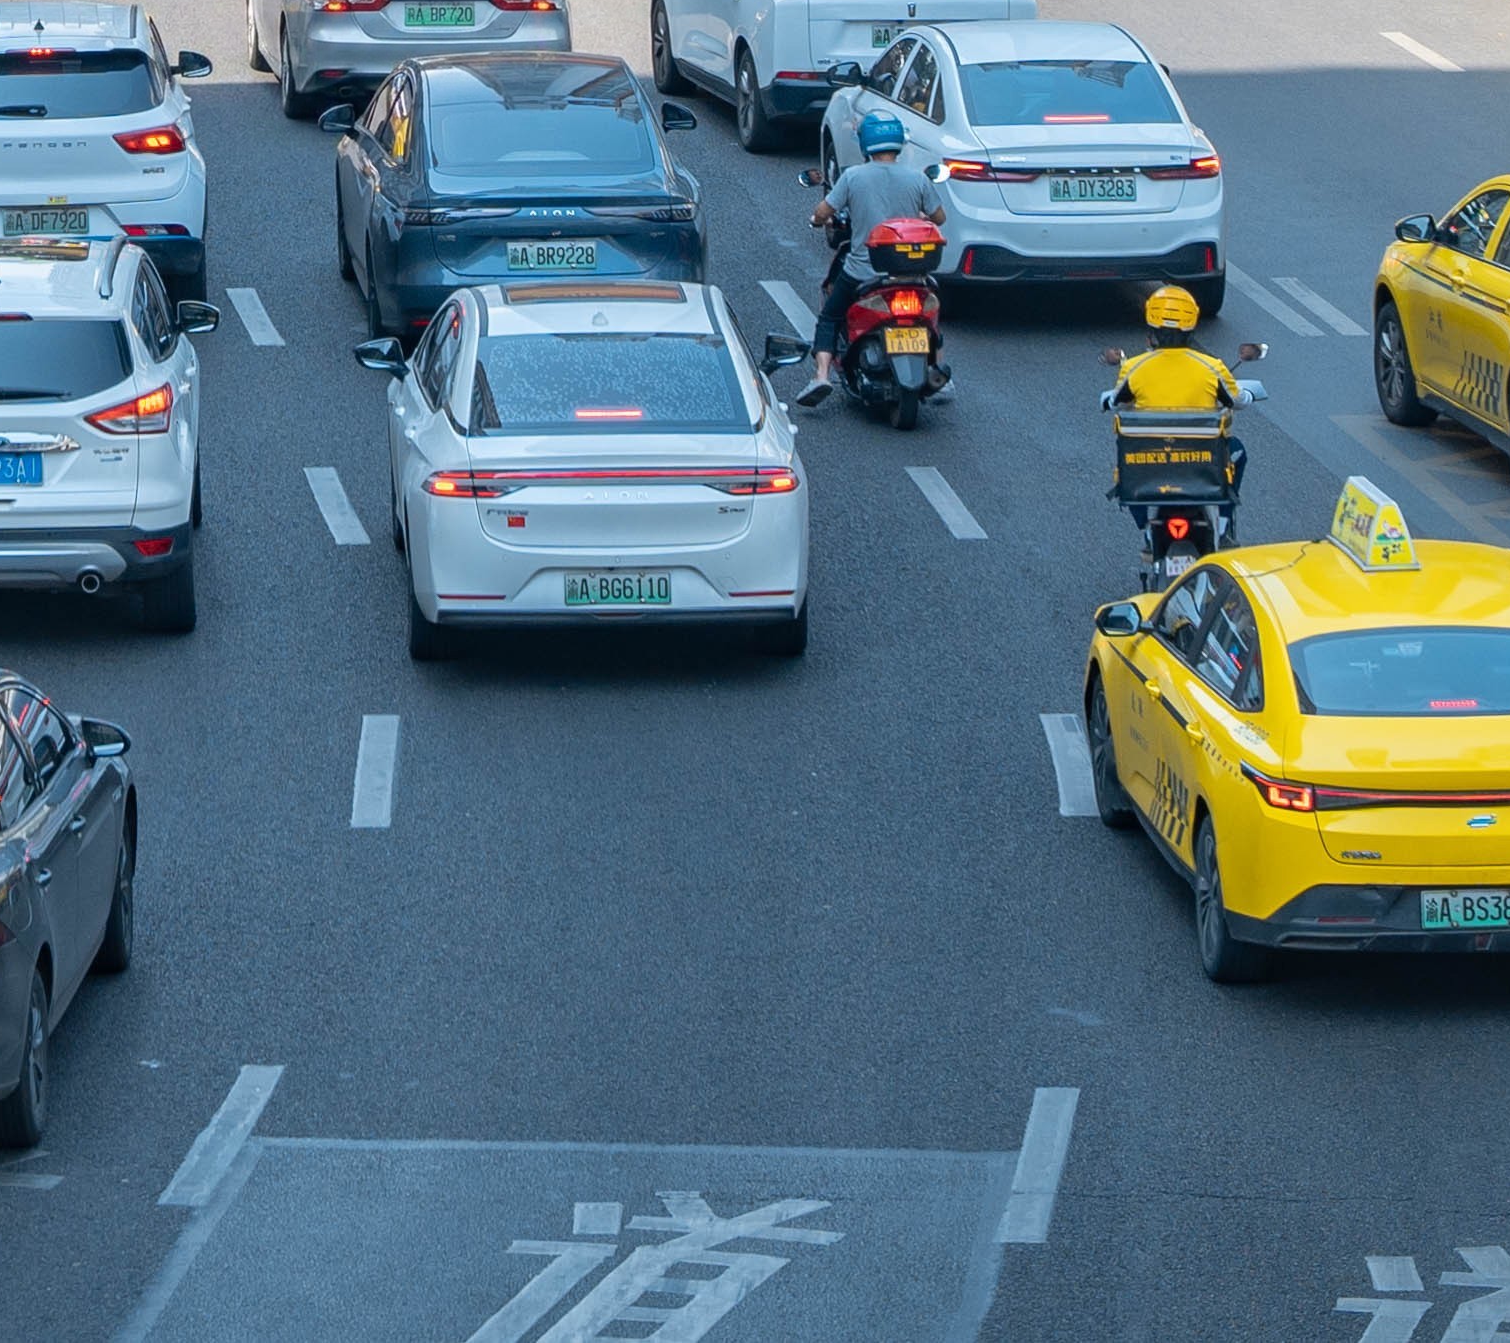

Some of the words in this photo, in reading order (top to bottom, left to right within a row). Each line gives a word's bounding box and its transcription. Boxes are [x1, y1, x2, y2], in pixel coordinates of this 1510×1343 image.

[1078, 176, 1135, 198] DY3283
[31, 209, 87, 233] DF7920
[536, 245, 596, 266] BR9228
[599, 575, 669, 601] BG6110
